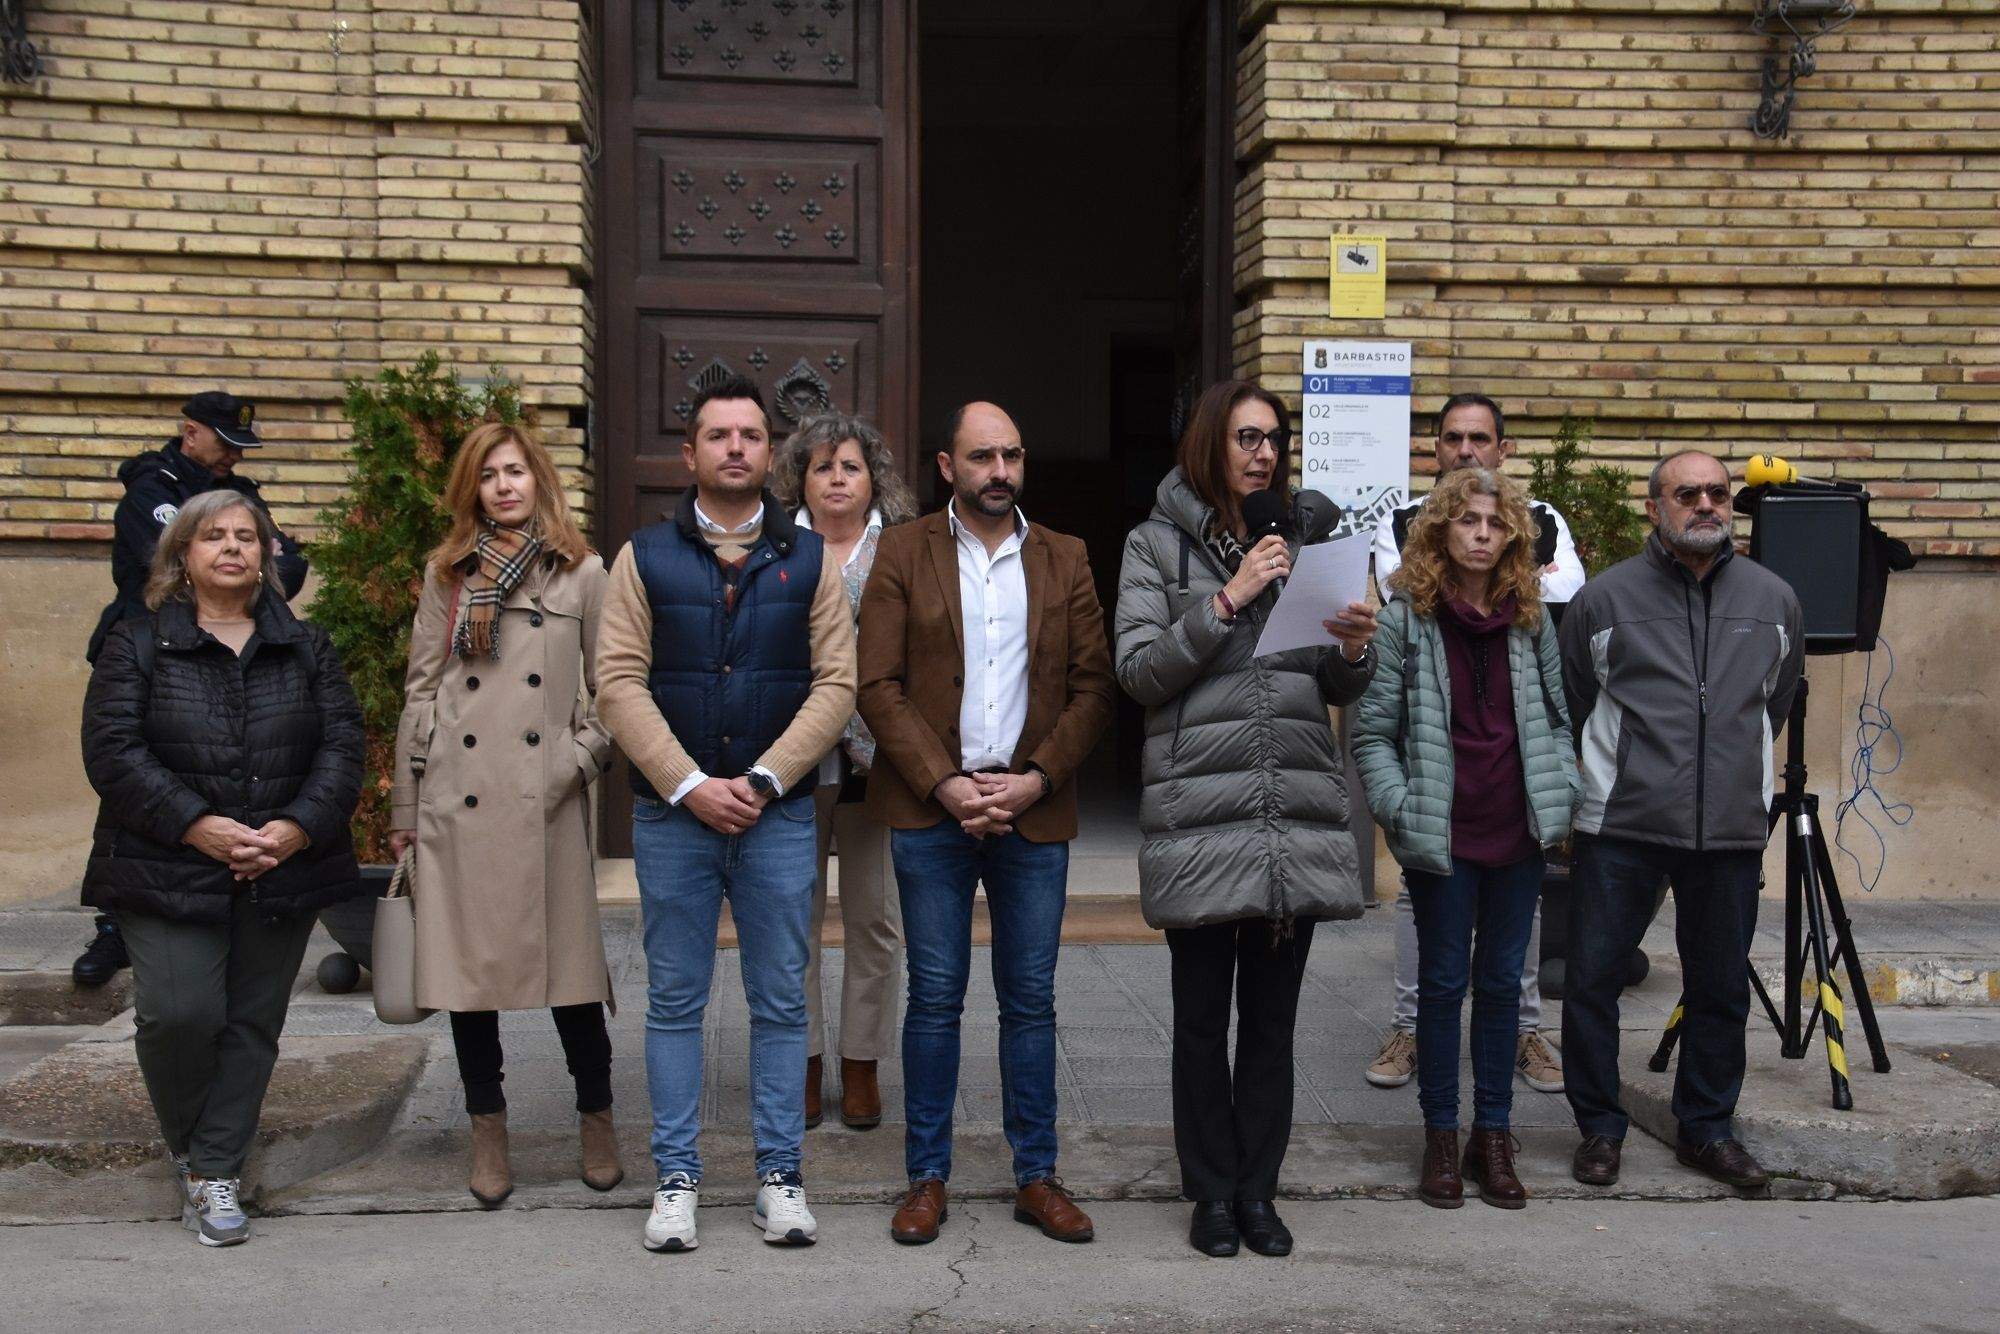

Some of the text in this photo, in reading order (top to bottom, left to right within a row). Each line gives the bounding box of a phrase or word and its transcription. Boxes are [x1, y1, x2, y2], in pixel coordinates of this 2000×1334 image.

[1334, 352, 1405, 362] BARBASTRO
[1309, 377, 1329, 392] 01
[1309, 404, 1330, 418] 02
[1309, 431, 1330, 446] 03
[1308, 458, 1329, 472] 04
